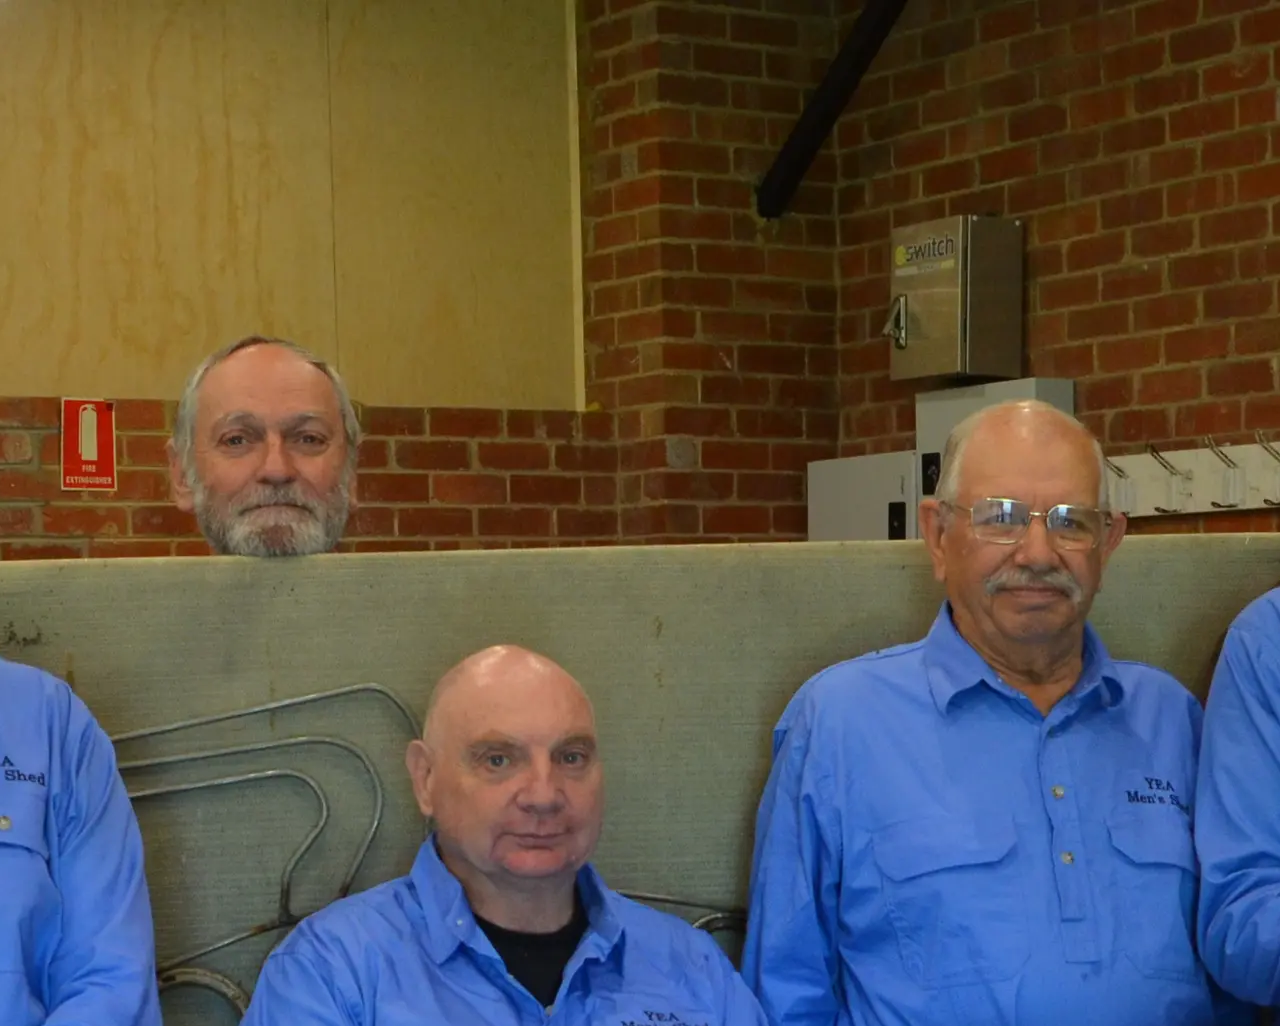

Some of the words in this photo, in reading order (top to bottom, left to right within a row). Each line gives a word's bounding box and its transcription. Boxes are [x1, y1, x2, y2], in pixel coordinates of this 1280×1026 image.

[906, 232, 954, 262] switch
[82, 464, 96, 473] FIRE
[65, 475, 112, 485] EXTINGUISHER
[4, 769, 46, 788] Shed
[1143, 776, 1176, 792] YEA
[1125, 790, 1166, 804] Men's
[643, 1010, 680, 1023] YEA
